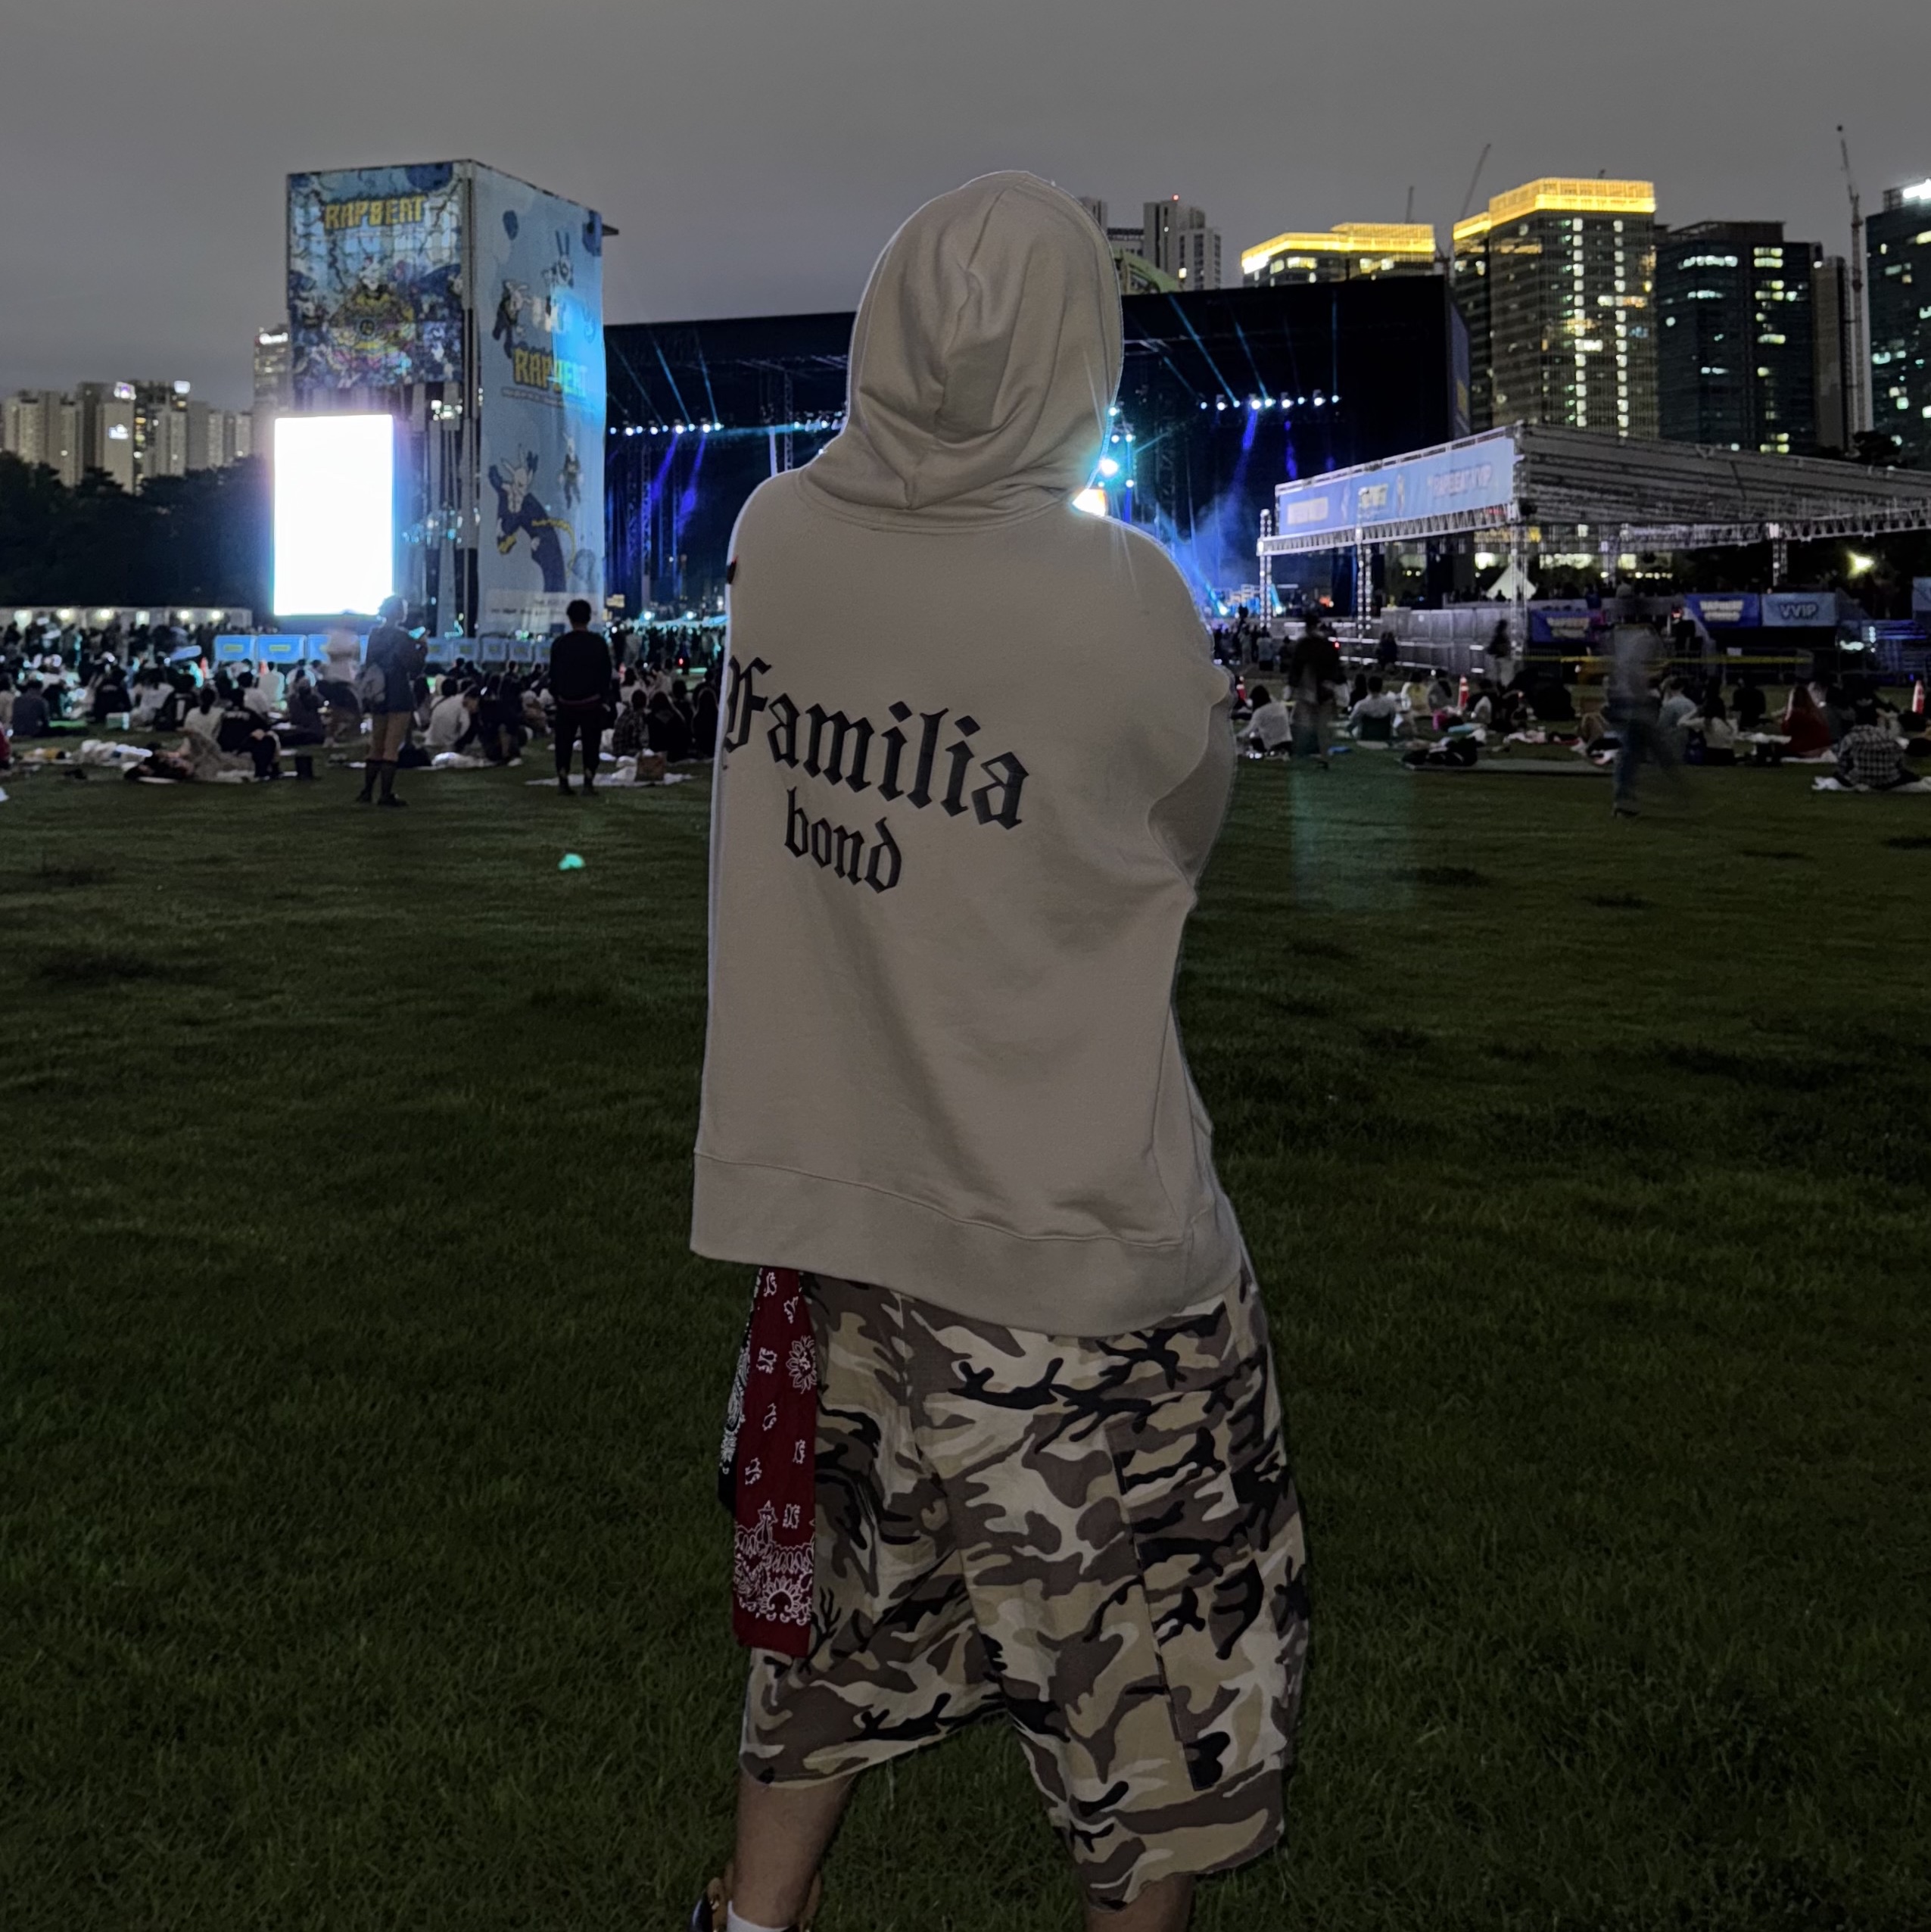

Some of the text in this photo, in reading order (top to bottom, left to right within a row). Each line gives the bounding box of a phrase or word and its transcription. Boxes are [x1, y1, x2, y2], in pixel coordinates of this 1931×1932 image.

[325, 195, 427, 229] RAPBEAT
[1780, 603, 1817, 619] VVIP
[724, 656, 1029, 830] Familia
[784, 786, 902, 894] bond
